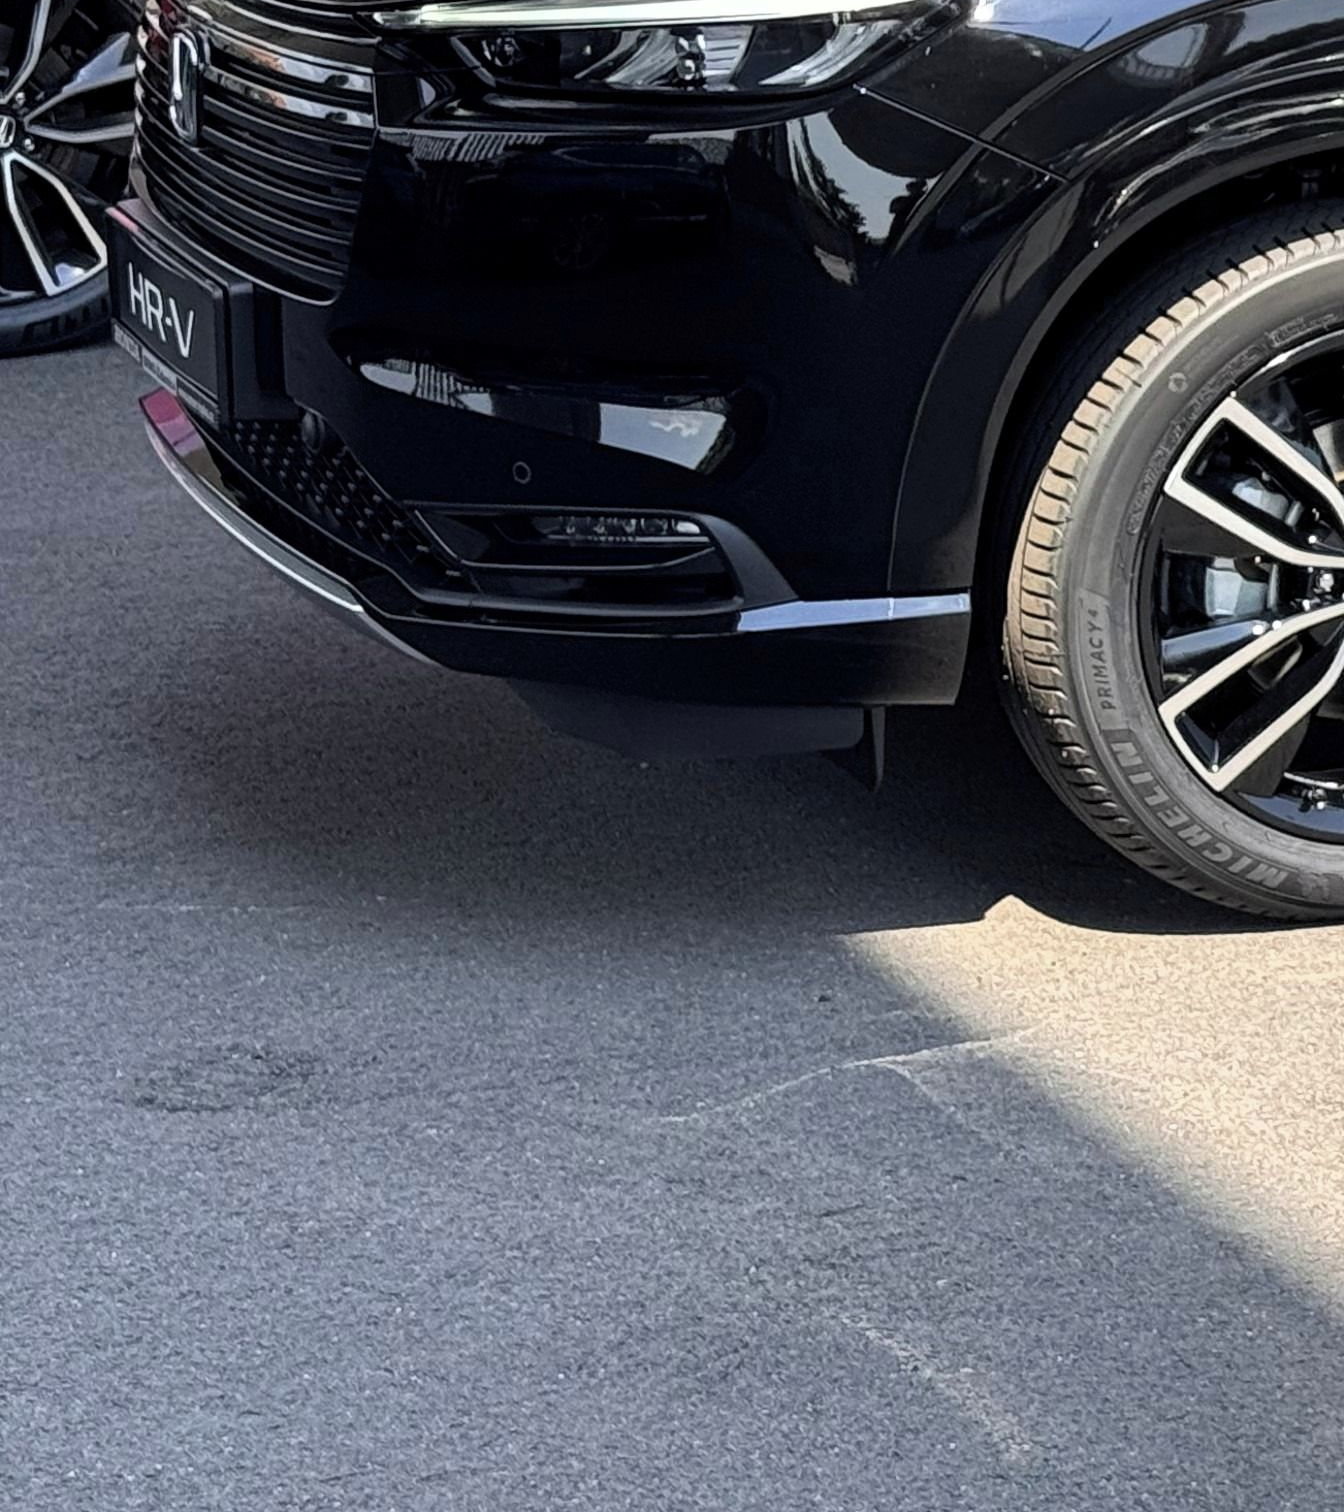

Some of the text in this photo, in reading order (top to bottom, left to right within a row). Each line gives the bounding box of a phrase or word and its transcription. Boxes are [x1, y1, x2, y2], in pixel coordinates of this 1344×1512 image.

[128, 261, 195, 359] HR-V
[1087, 626, 1117, 710] PRIMACY
[1110, 740, 1290, 889] MICHELIN
